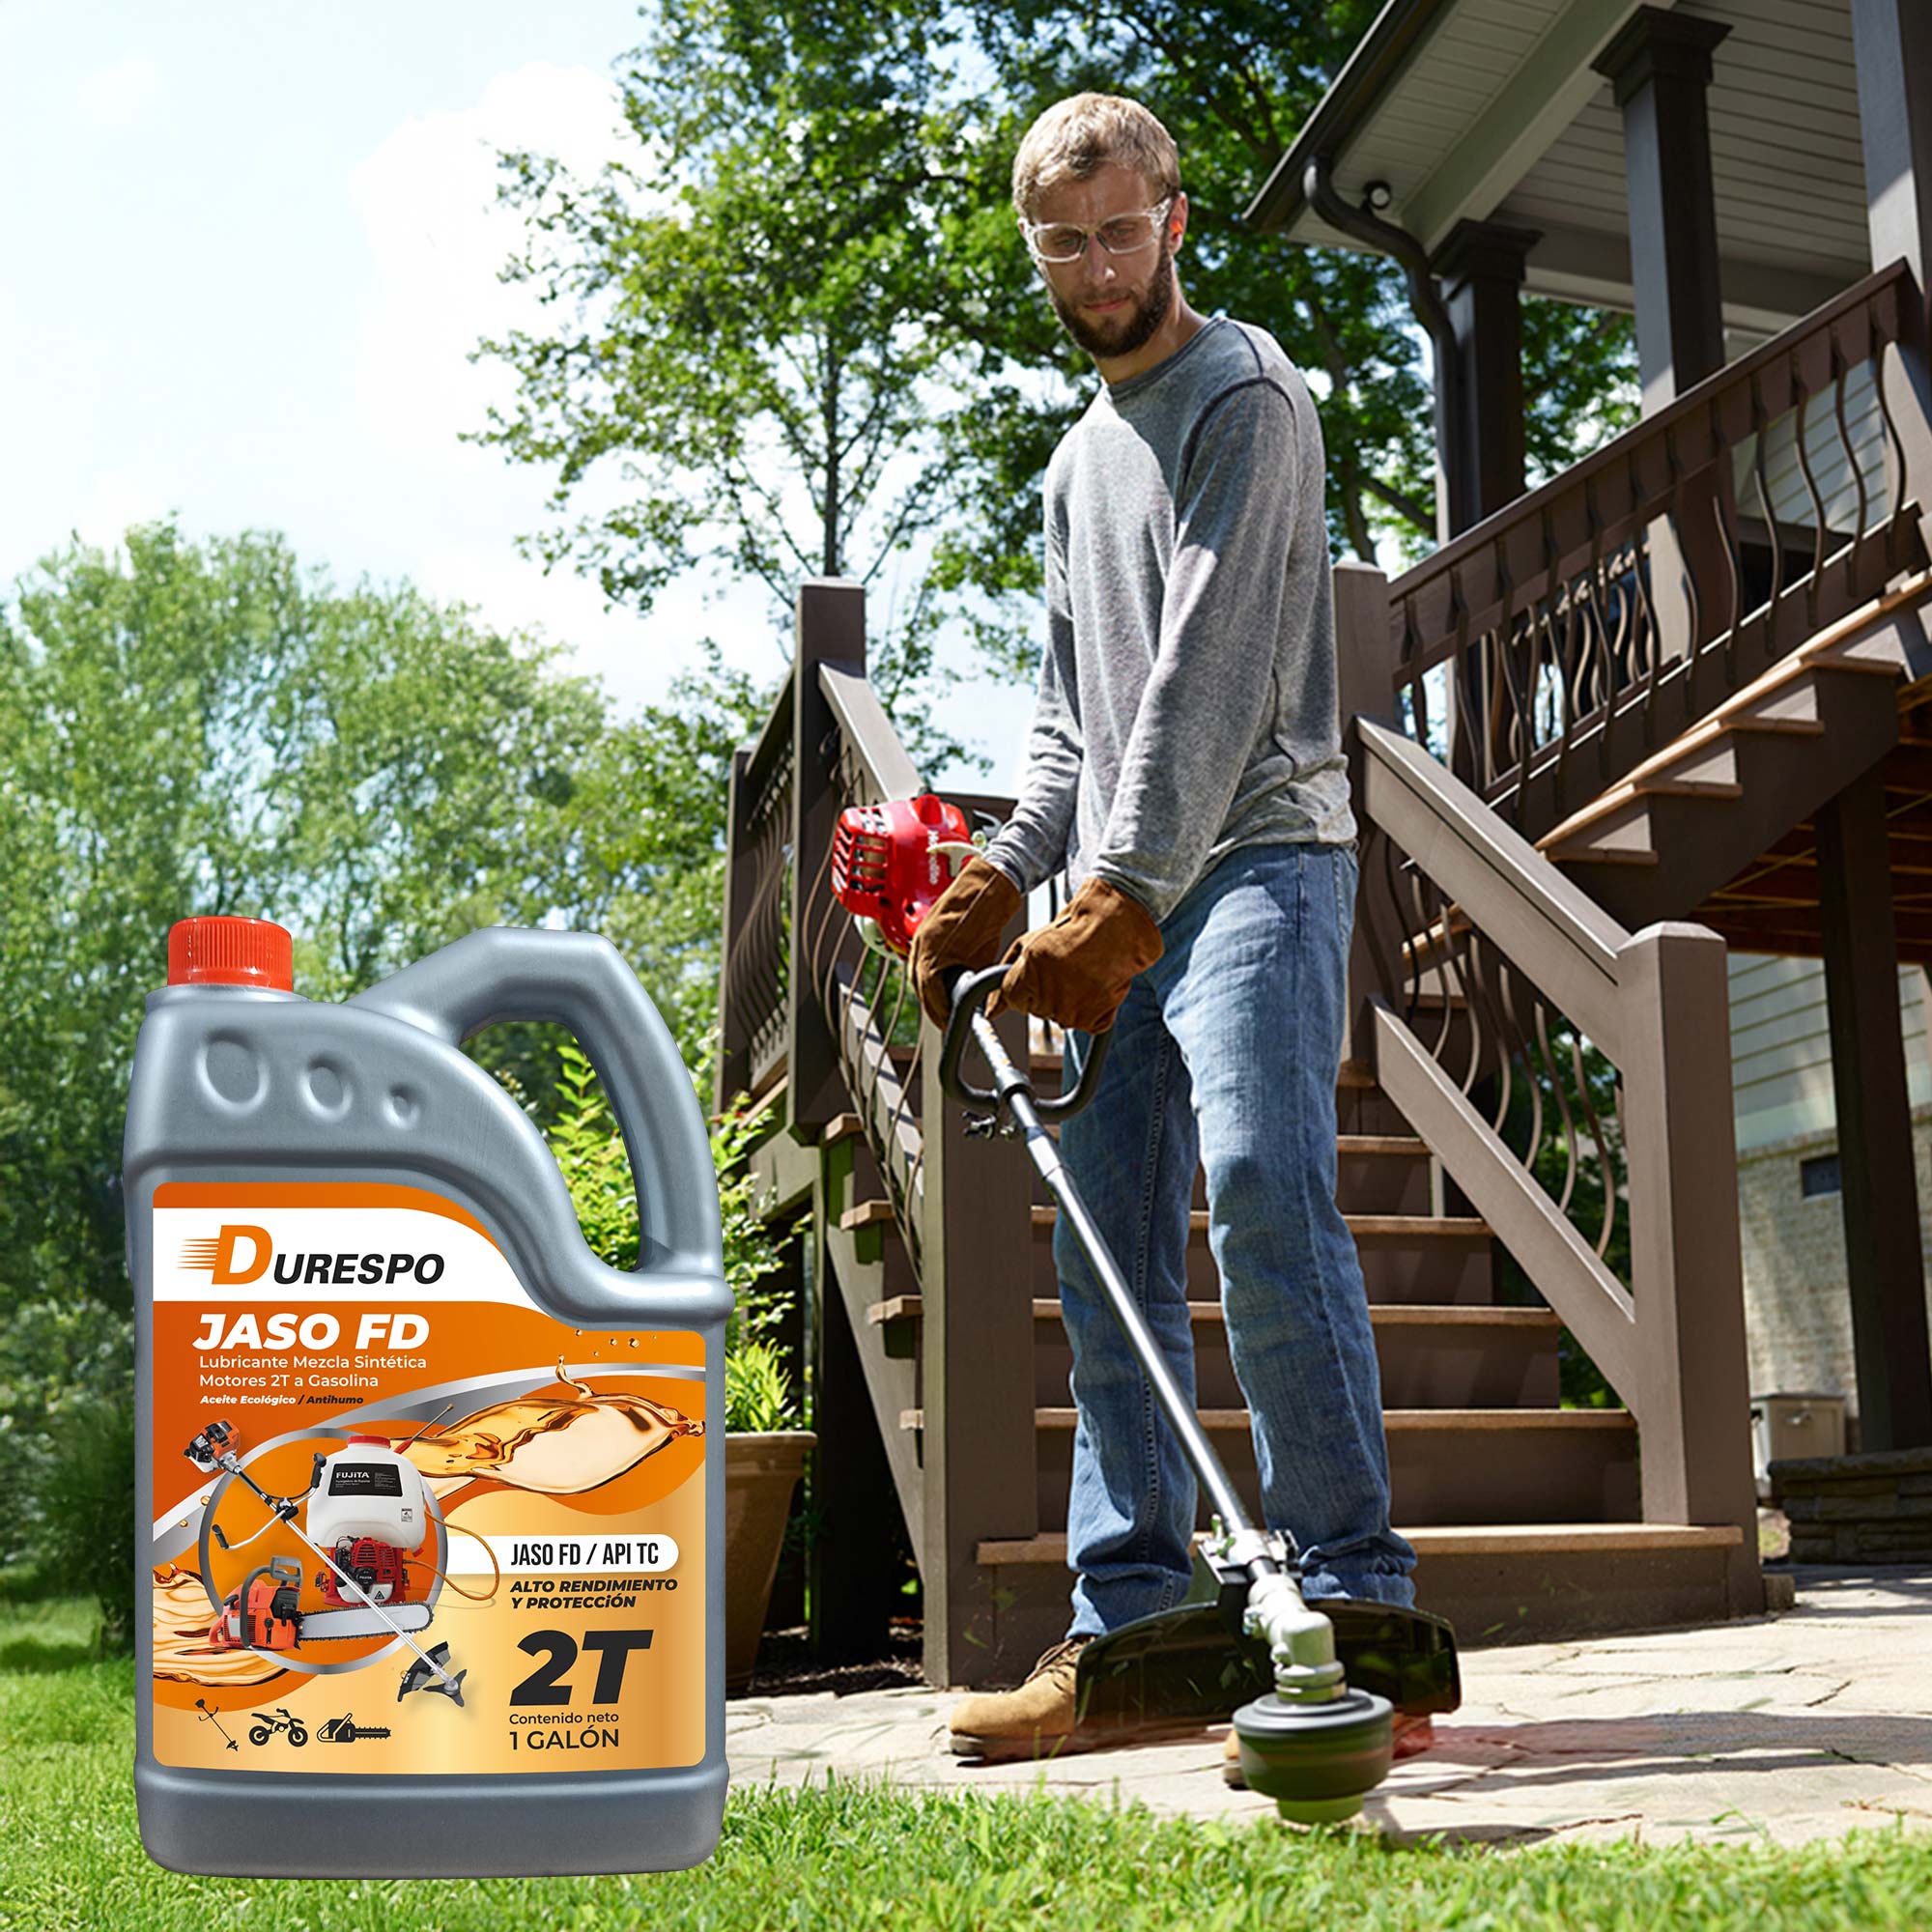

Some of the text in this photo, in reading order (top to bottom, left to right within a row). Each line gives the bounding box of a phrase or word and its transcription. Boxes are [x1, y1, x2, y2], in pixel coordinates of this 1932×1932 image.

[212, 1224, 445, 1285] DURESPO
[192, 1313, 430, 1350] JASO FD
[199, 1354, 427, 1369] Lubricante Mezcla Sintética
[199, 1374, 379, 1387] Motores 2T a Gasolina
[199, 1394, 364, 1406] Aceite Ecológico / Antihumo
[510, 1542, 659, 1566] JASO FD / API TC
[510, 1578, 678, 1593] ALTO RENDIMIENTO
[510, 1597, 524, 1609] Y
[509, 1630, 655, 1706] 2T
[509, 1713, 619, 1725] Contenido neto
[509, 1725, 619, 1750] 1 GALÓN
